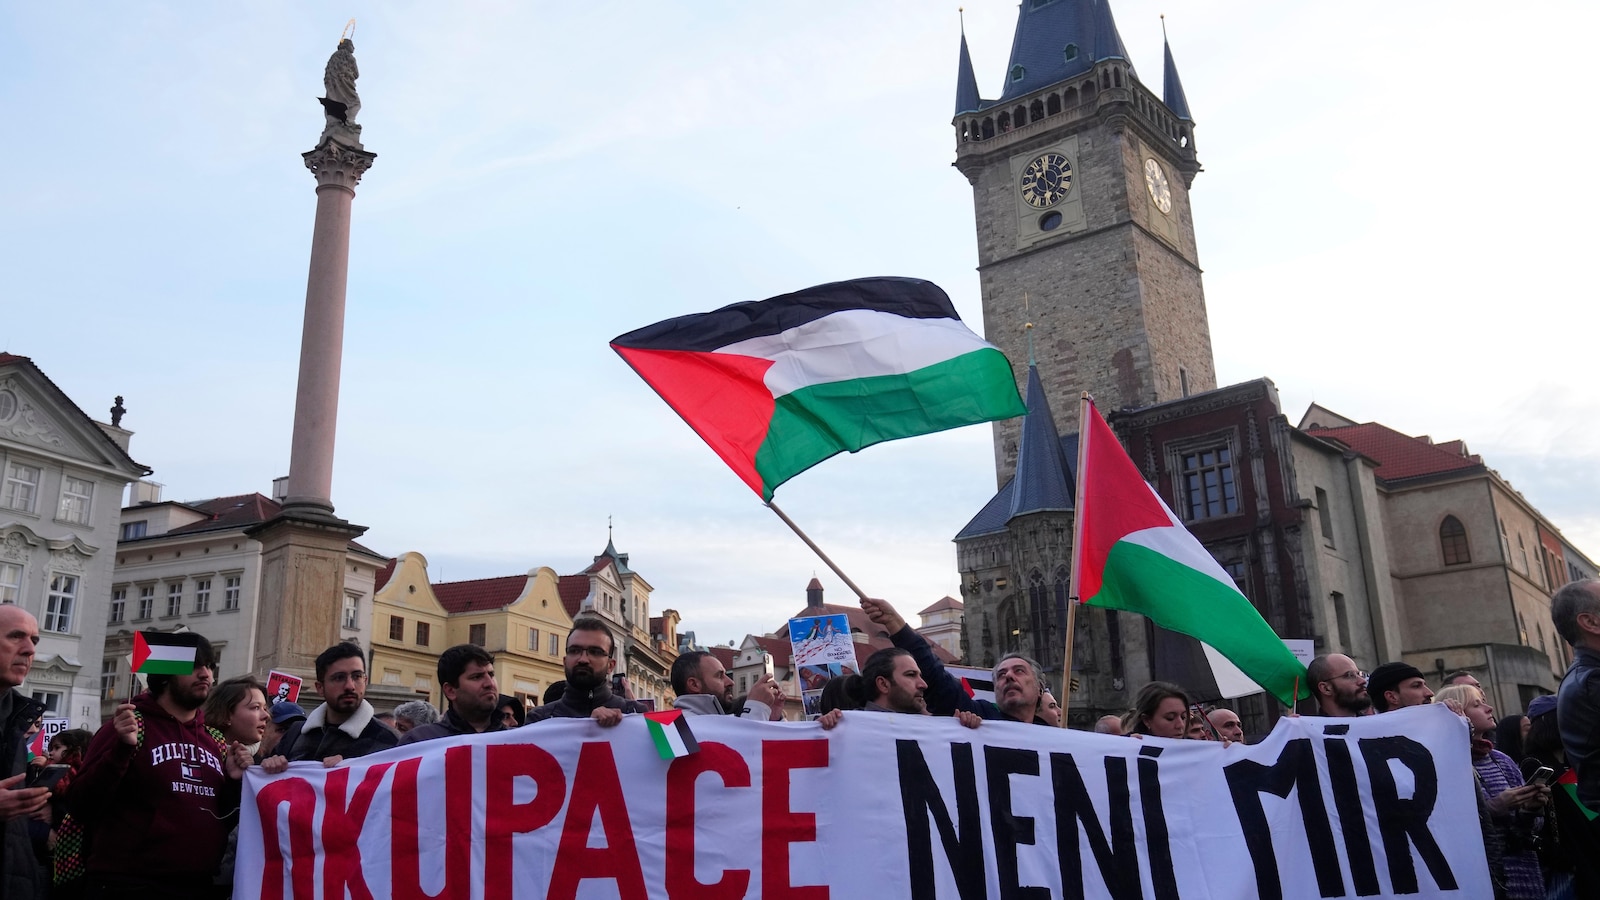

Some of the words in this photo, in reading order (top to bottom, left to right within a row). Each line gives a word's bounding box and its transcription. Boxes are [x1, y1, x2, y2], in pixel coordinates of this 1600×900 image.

[42, 720, 67, 733] IDÉ
[151, 742, 224, 776] HILFIGER
[256, 739, 830, 900] OKUPACE
[896, 739, 1180, 900] NENÍ
[1223, 724, 1459, 900] MÍR
